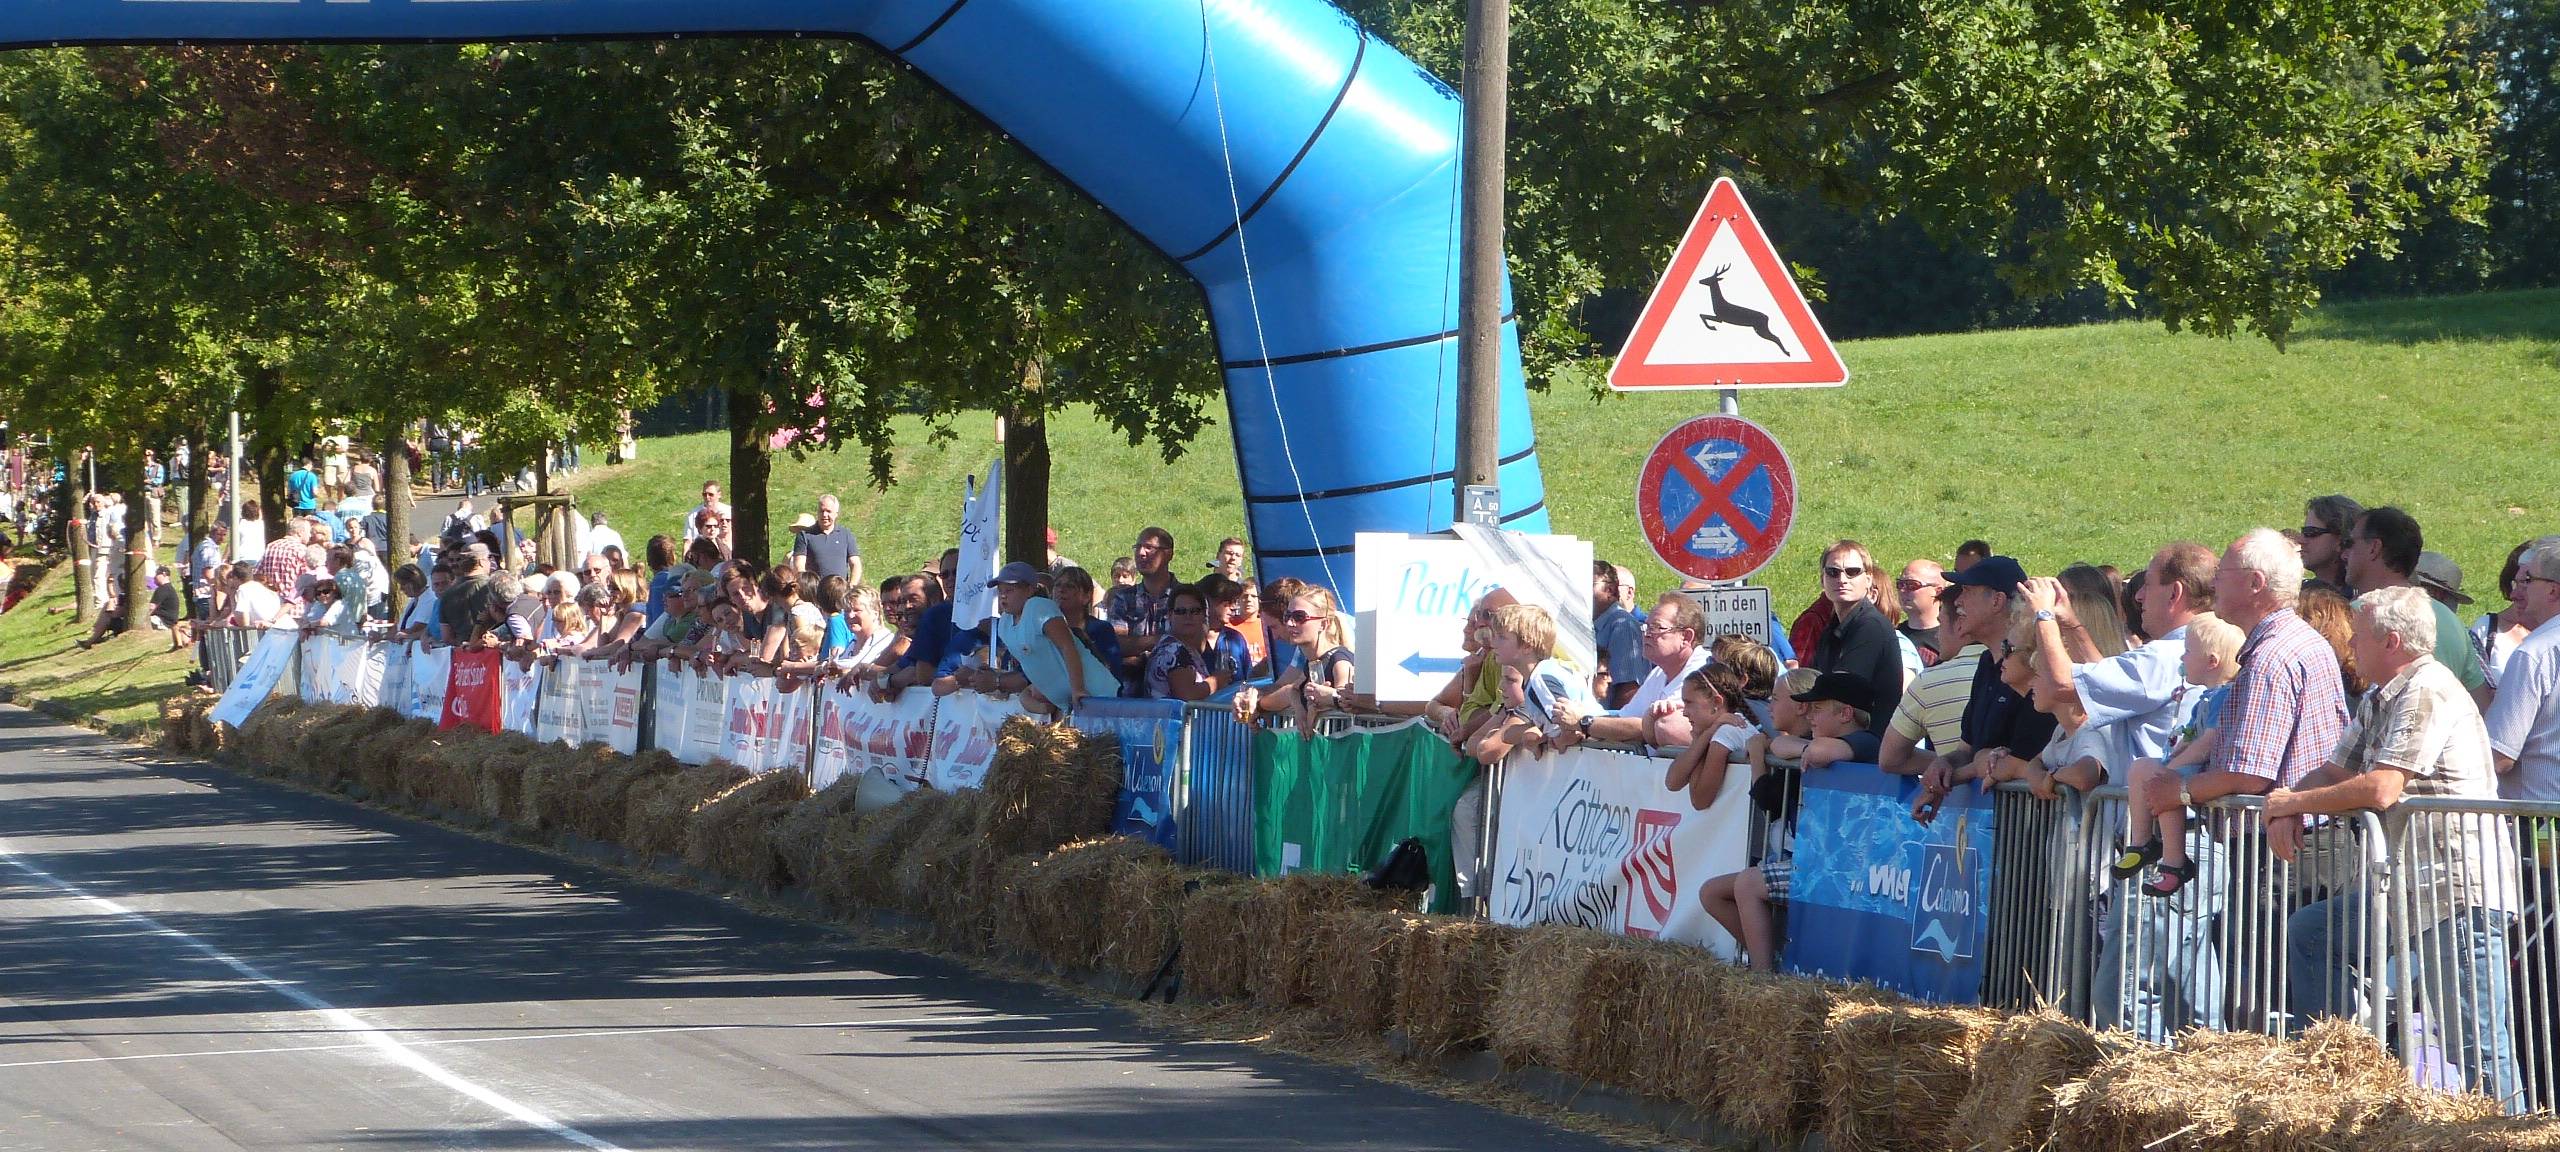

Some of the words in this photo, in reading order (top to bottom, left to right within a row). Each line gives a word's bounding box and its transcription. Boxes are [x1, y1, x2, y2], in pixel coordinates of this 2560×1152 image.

[1715, 594, 1727, 612] in
[1732, 595, 1757, 612] den
[1539, 778, 1632, 873] Köttgen
